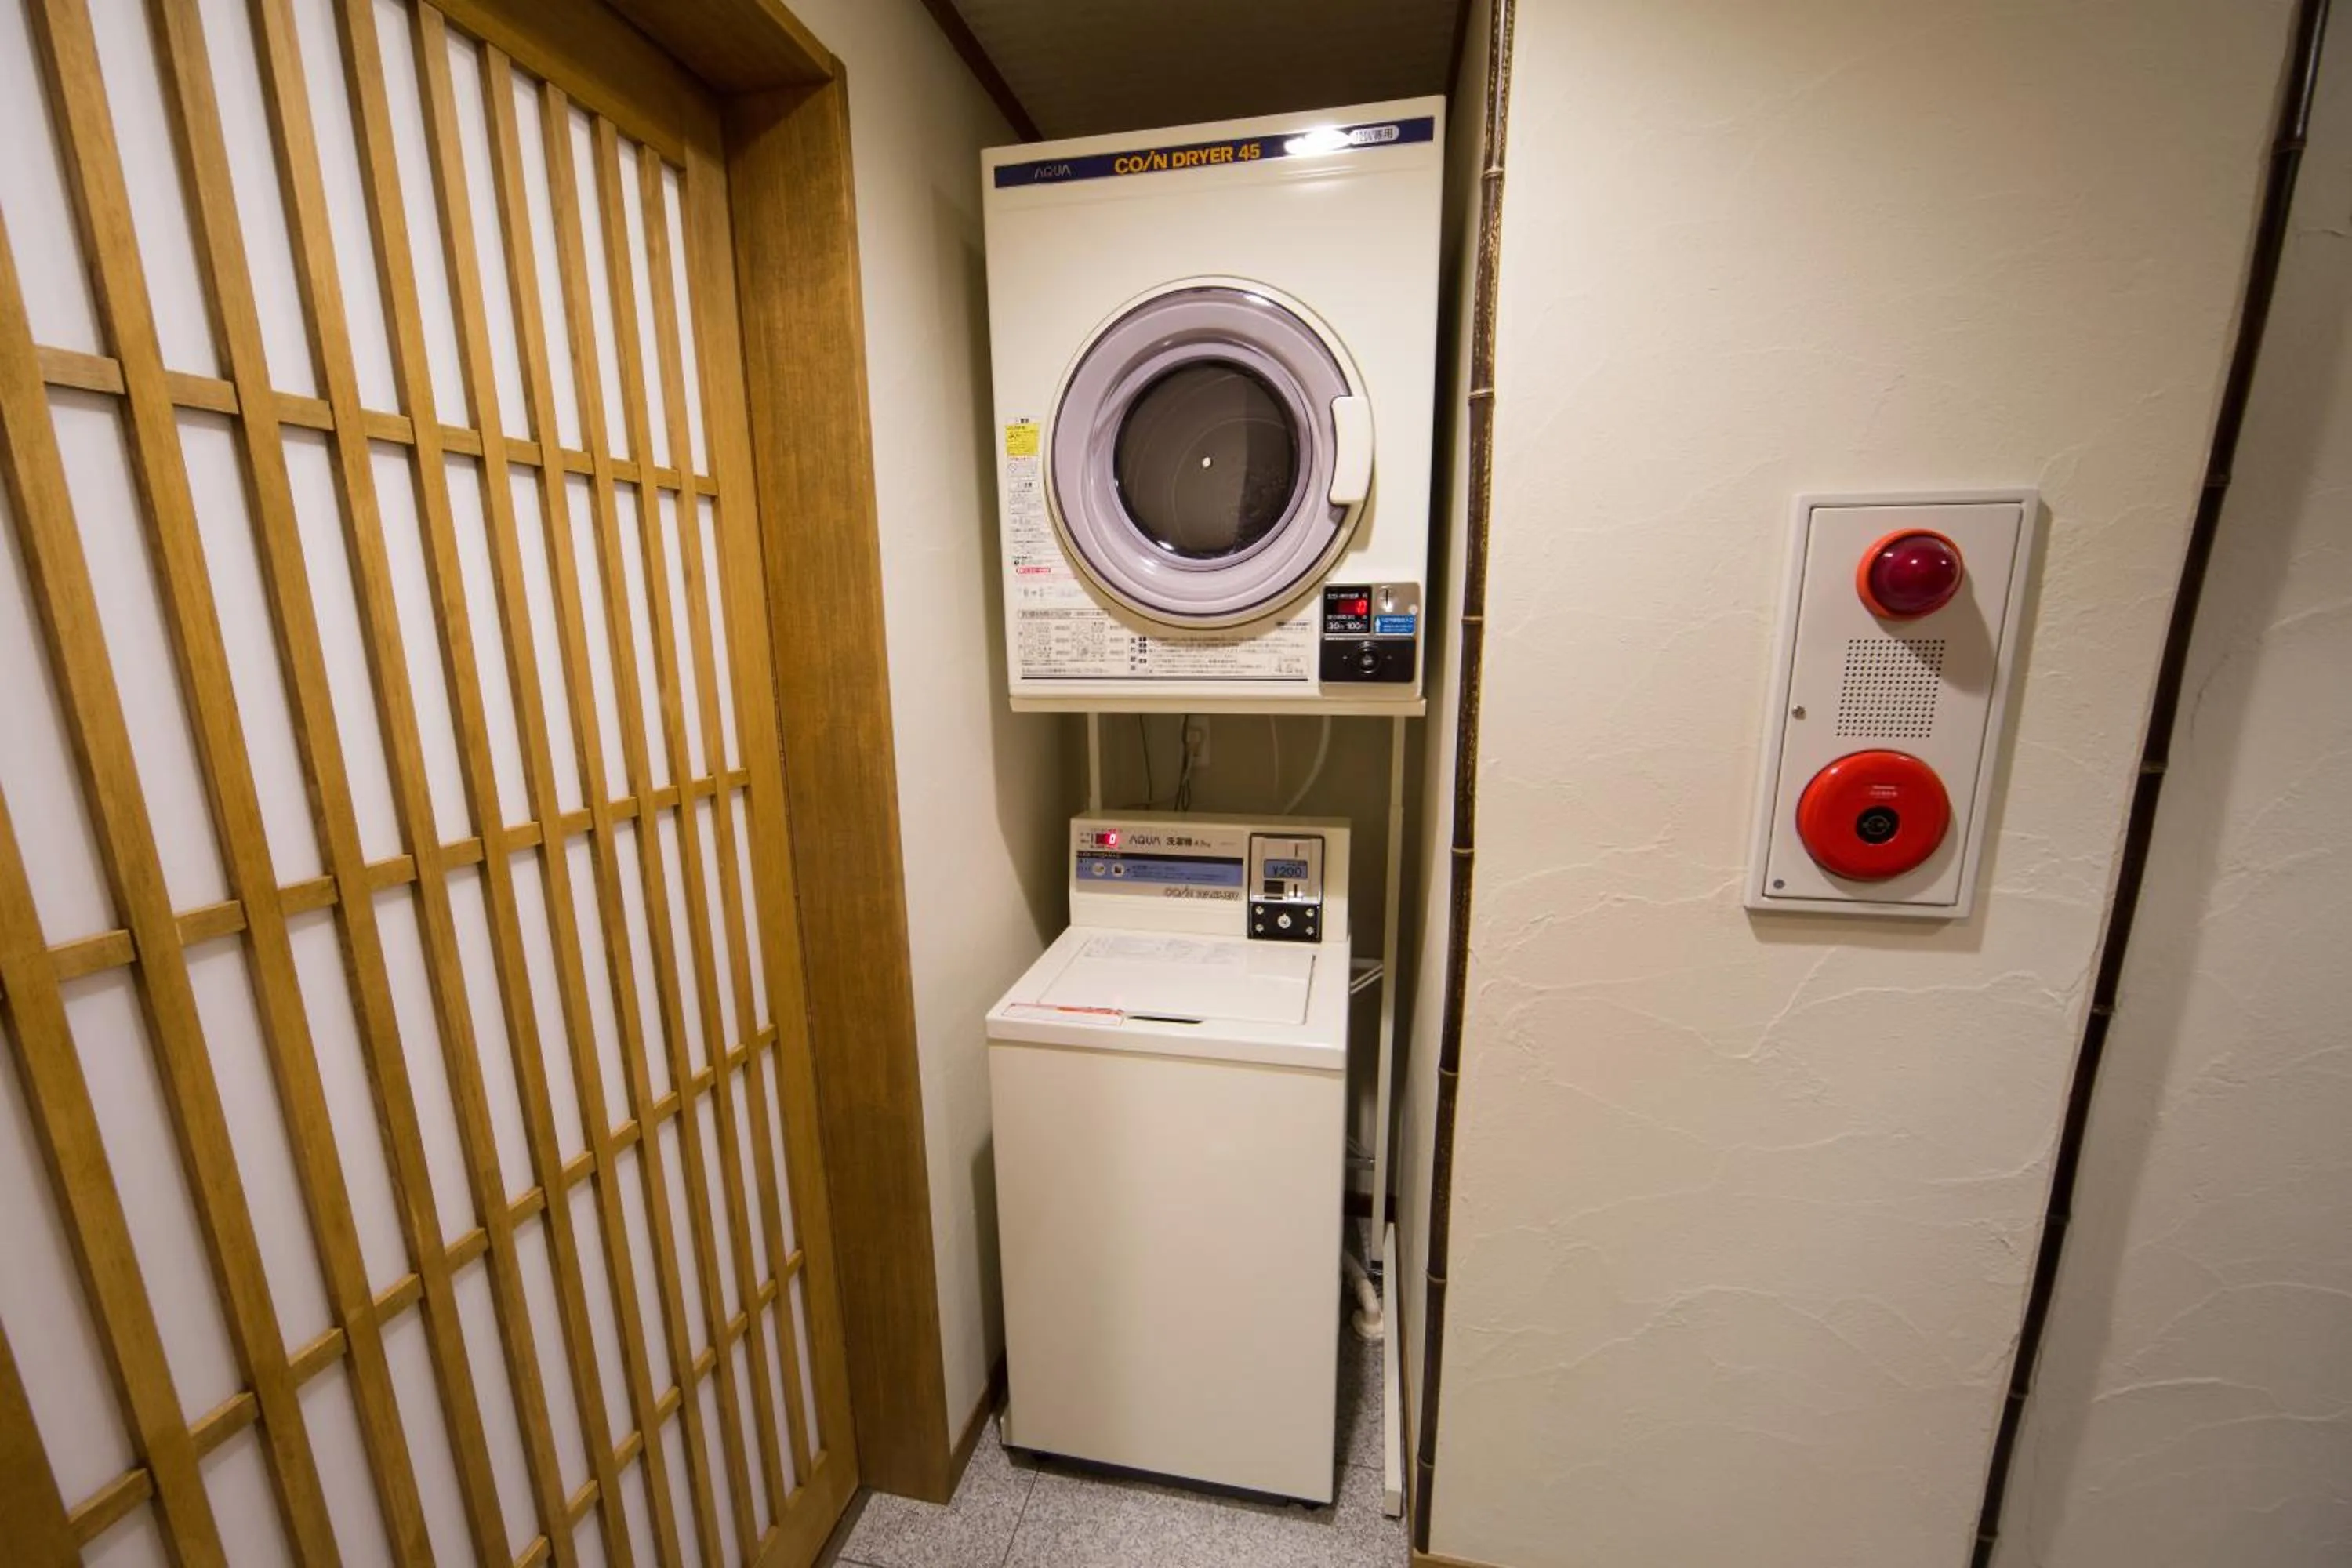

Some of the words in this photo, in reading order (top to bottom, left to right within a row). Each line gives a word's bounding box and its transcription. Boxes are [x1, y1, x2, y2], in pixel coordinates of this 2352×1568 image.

[1172, 146, 1234, 169] DRYER
[1238, 143, 1261, 162] 45
[1129, 834, 1161, 846] AQUA
